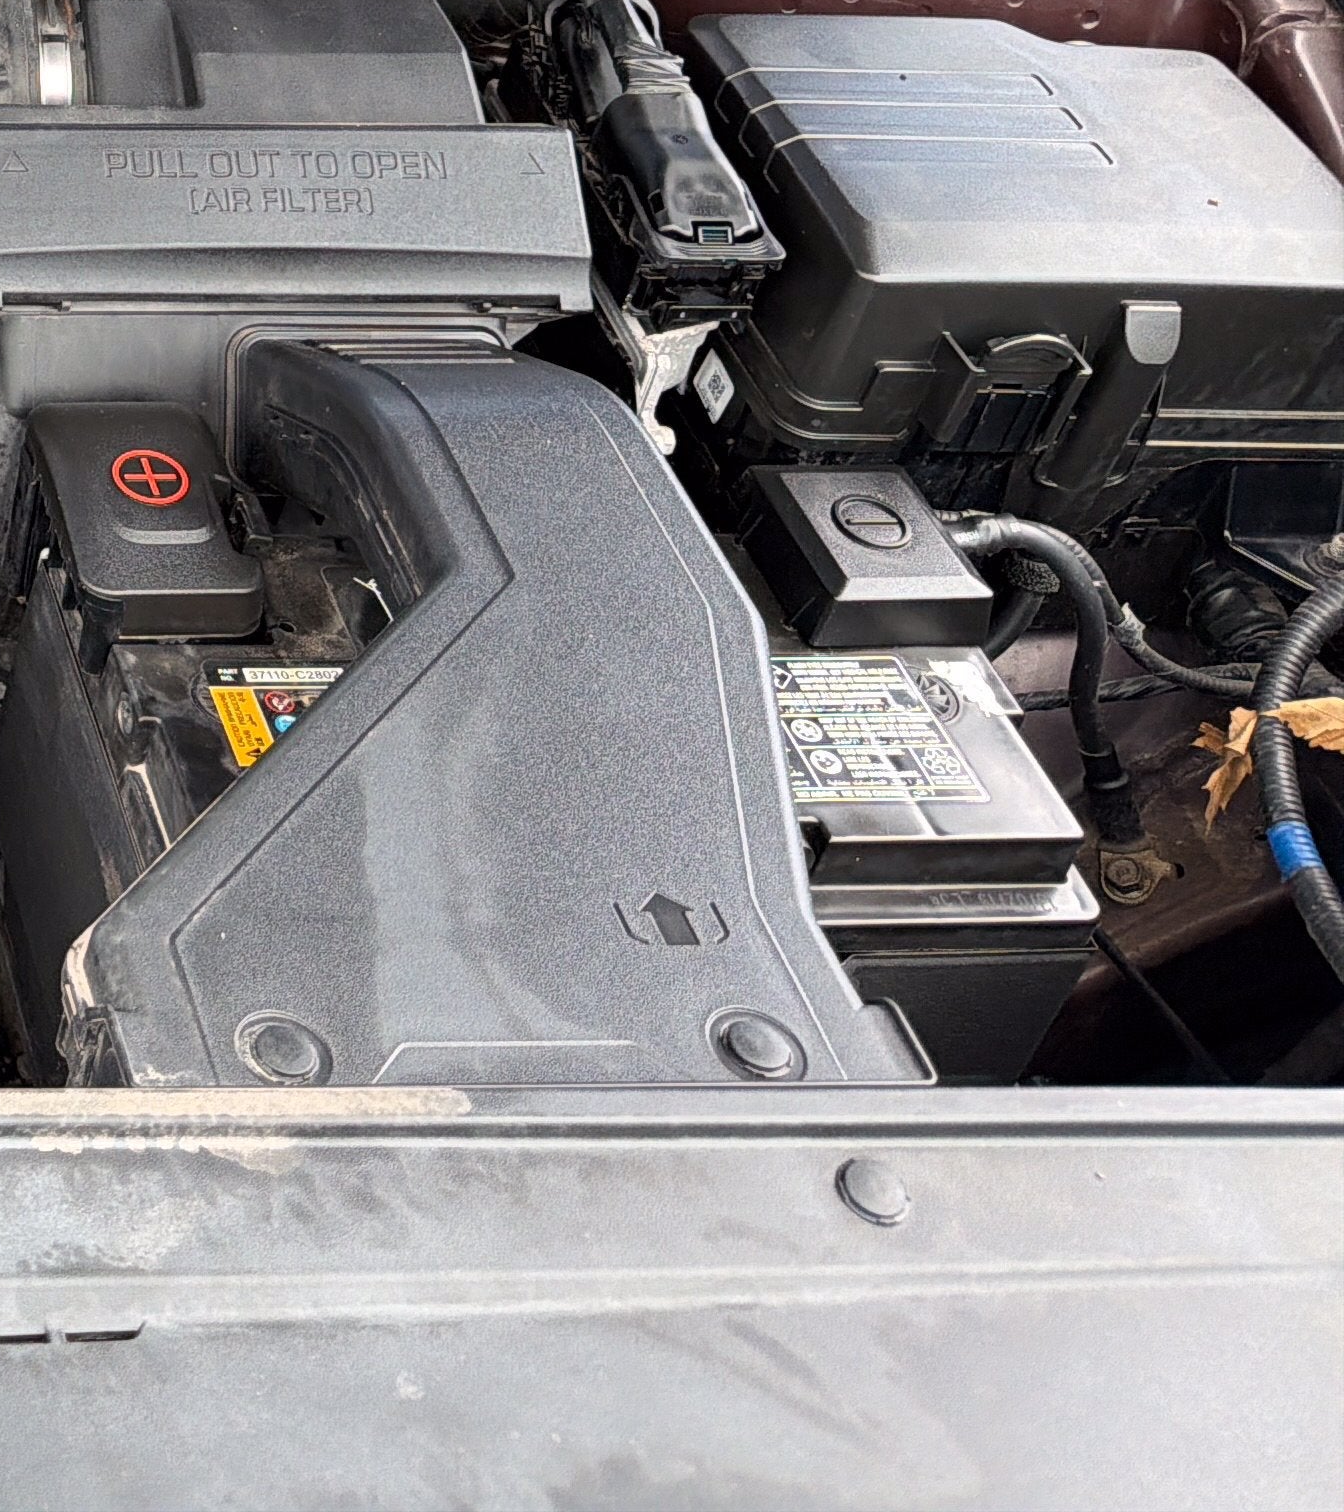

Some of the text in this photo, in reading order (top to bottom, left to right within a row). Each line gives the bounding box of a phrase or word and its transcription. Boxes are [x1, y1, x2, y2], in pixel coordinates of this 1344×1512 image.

[102, 148, 449, 180] PULL OUT TO OPEN
